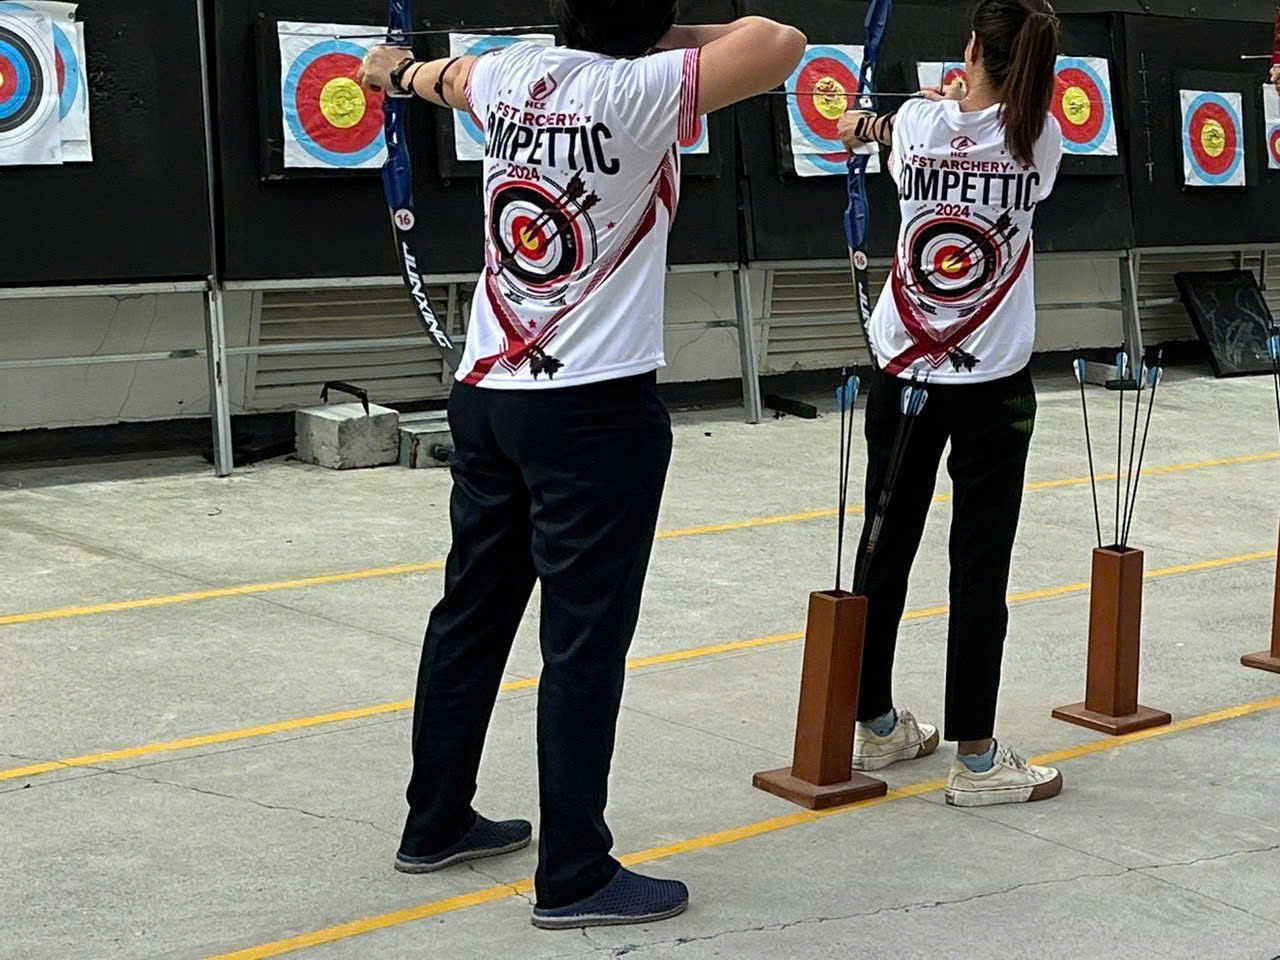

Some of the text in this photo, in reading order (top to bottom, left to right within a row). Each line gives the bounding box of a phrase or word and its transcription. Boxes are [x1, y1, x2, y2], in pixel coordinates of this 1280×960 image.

[484, 104, 621, 176] OMPETTIC
[507, 163, 540, 182] 2024
[940, 160, 1009, 173] ARCHERY
[900, 158, 1041, 212] OMPETTIC
[397, 214, 411, 226] 16
[935, 203, 971, 218] 2024
[402, 241, 453, 350] JUNXING
